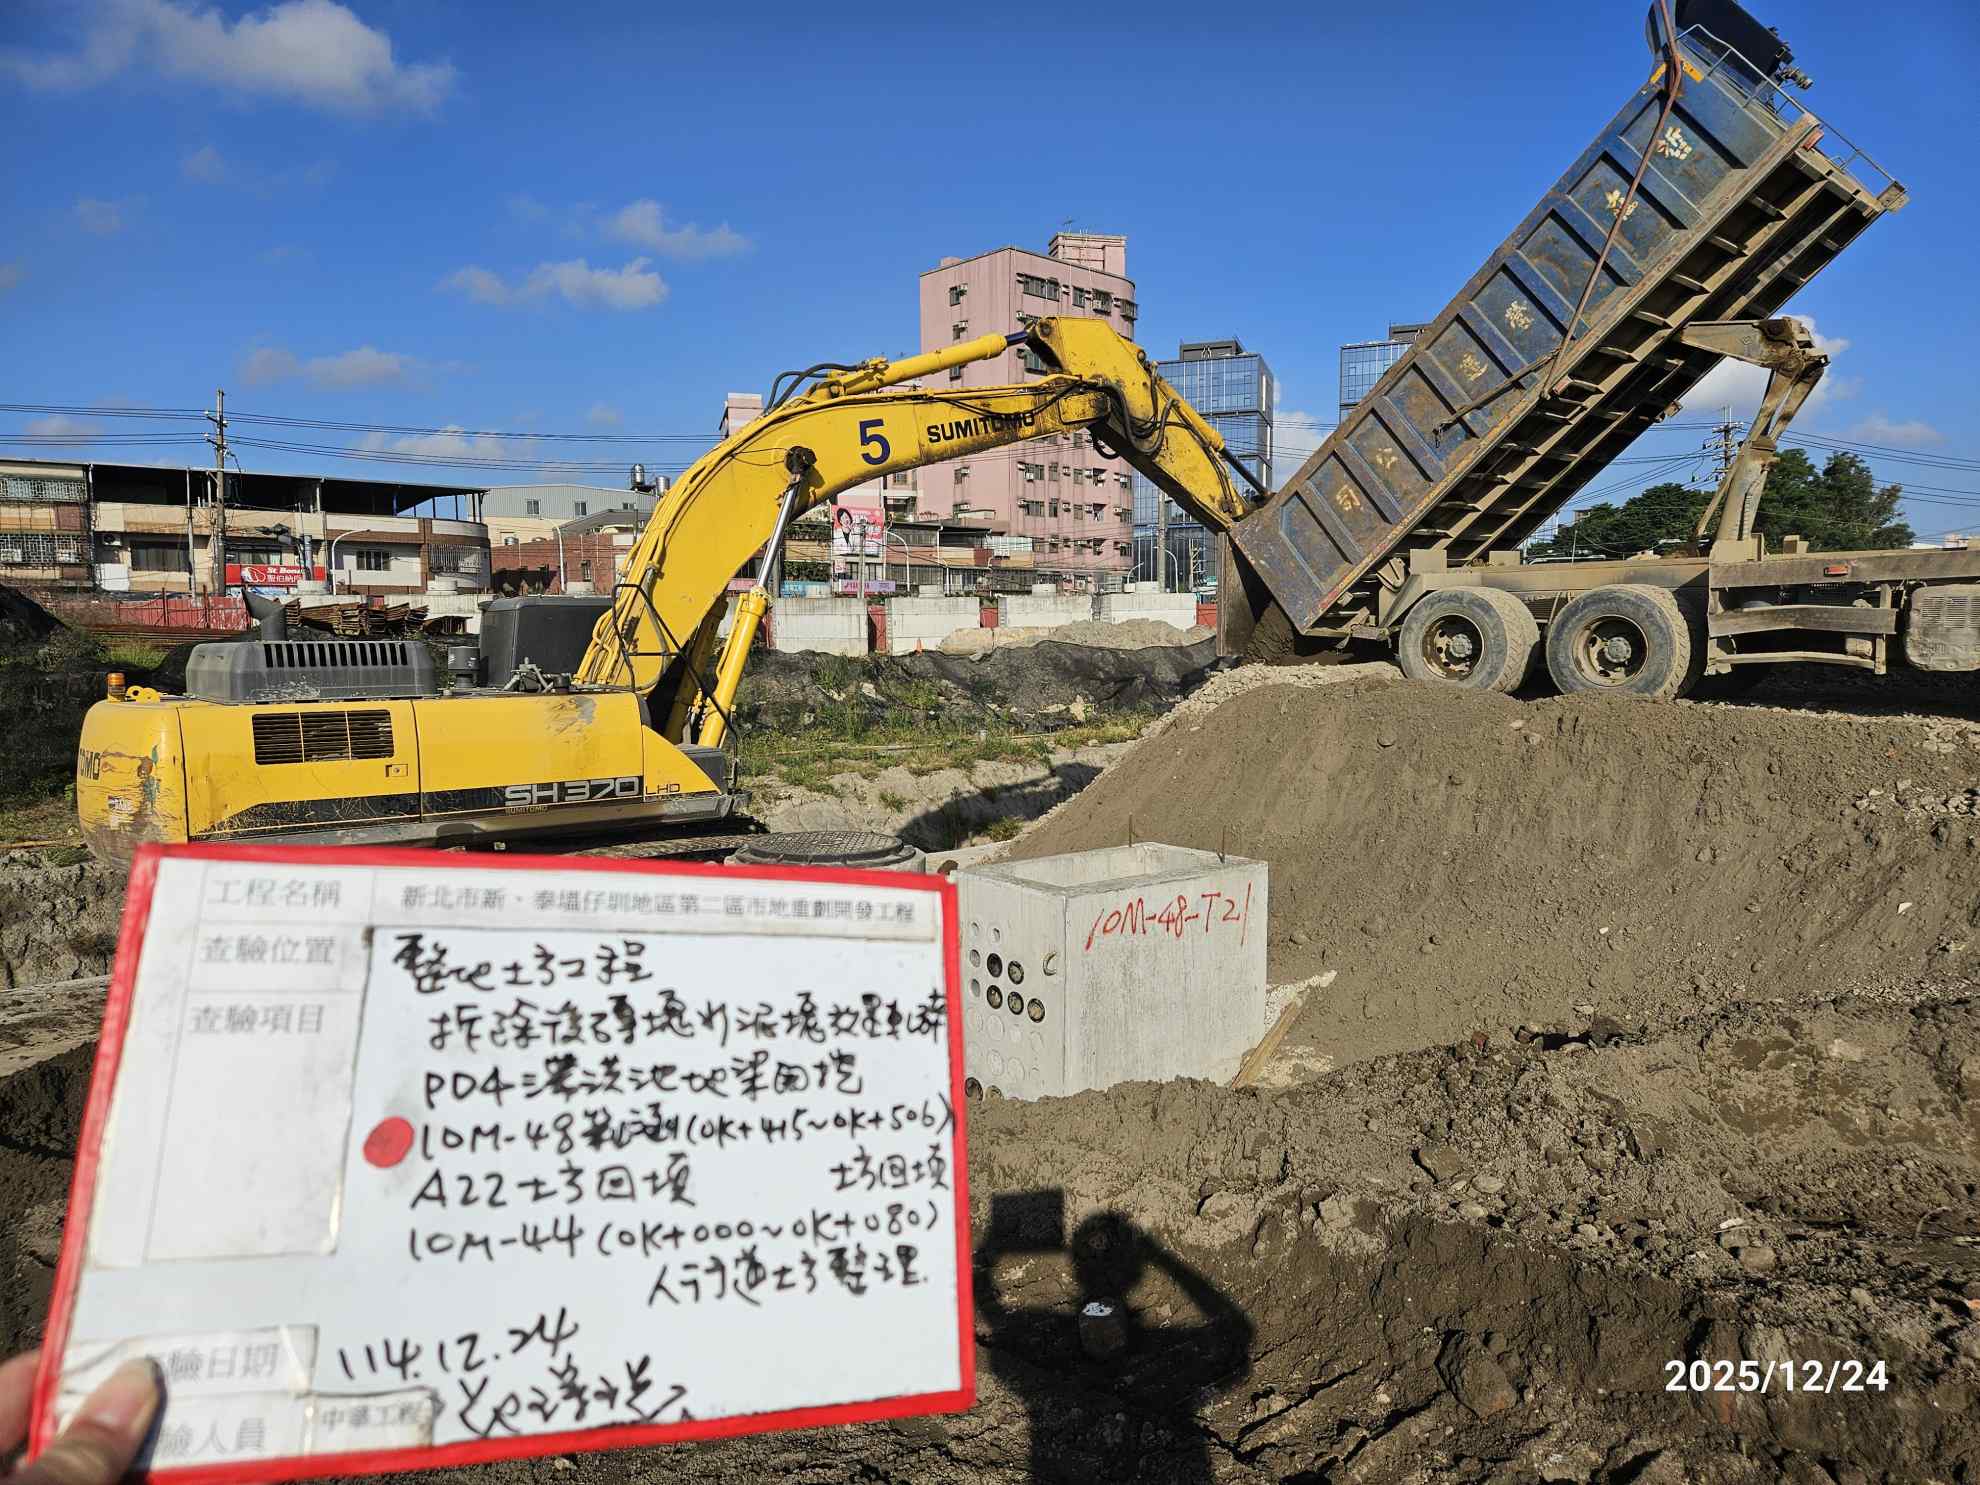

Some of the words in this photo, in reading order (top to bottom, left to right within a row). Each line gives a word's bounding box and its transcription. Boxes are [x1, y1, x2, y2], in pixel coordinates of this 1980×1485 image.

[858, 418, 891, 466] 5
[209, 879, 342, 909] 工程名稱
[202, 935, 336, 965] 查驗位置
[190, 1003, 325, 1036] 查驗項目
[163, 1343, 280, 1383] 驗日期
